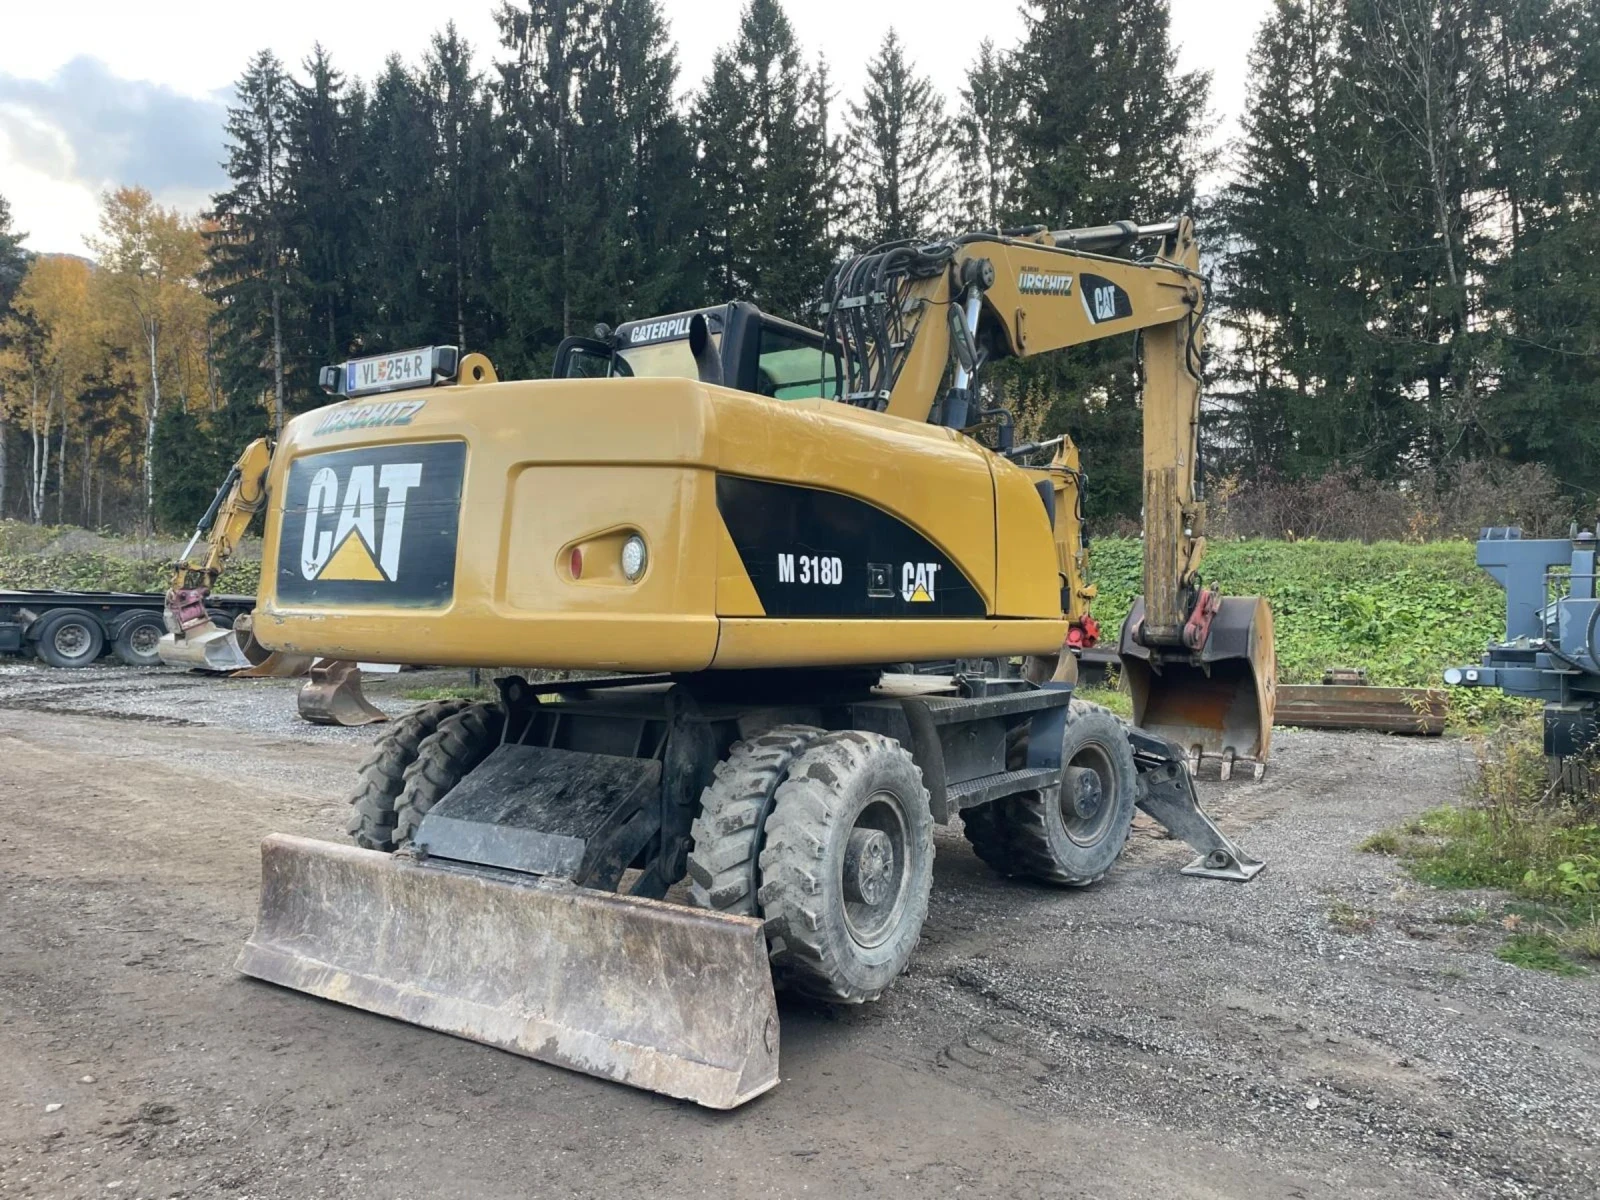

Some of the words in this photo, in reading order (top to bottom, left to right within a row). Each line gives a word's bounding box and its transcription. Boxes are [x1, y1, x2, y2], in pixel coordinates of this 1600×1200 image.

[1018, 273, 1073, 296] URSCHITZ
[1094, 285, 1115, 319] CAT
[362, 363, 377, 385] VL
[387, 358, 411, 381] 254
[414, 355, 423, 377] R
[312, 400, 427, 436] URSCHITZ
[301, 463, 423, 582] CAT
[778, 553, 795, 583] M
[799, 555, 843, 585] 318D
[902, 561, 938, 602] CAT
